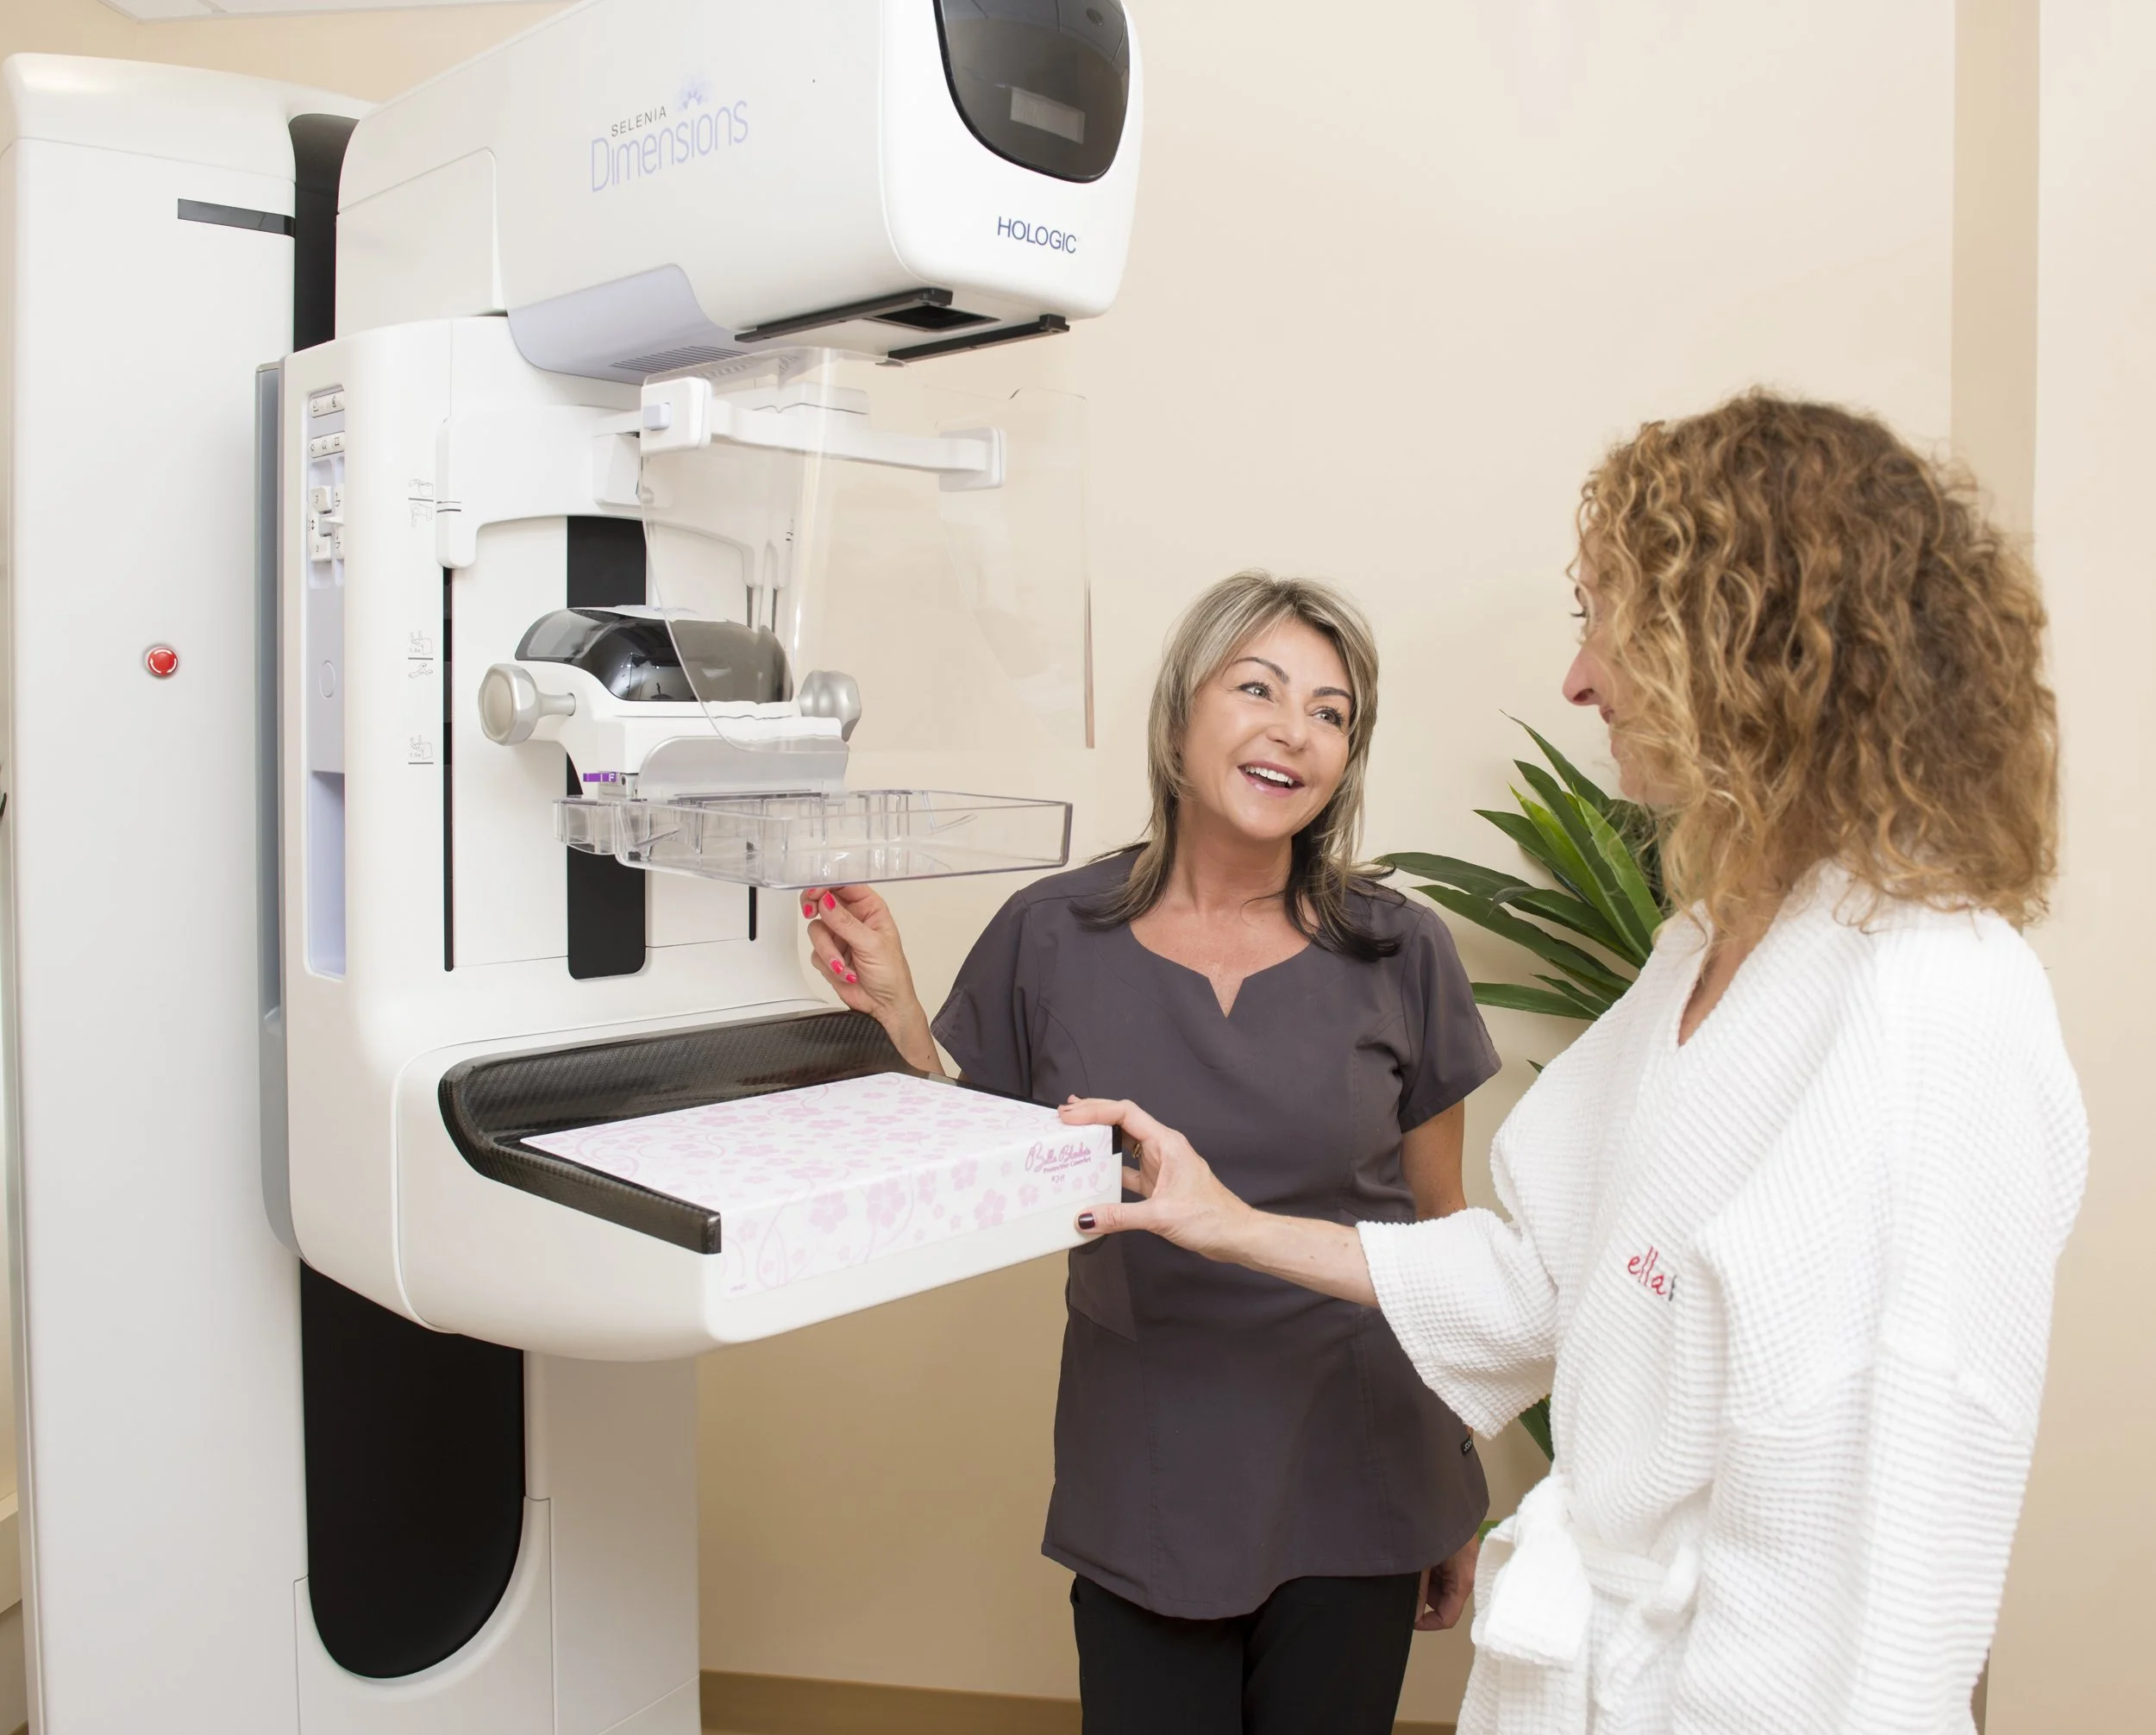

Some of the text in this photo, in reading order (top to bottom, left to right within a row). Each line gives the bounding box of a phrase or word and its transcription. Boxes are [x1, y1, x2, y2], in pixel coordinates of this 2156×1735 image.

[611, 105, 667, 137] SELENIA
[591, 99, 749, 192] Dimensions
[997, 216, 1077, 254] HOLOGIC
[1627, 1244, 1666, 1295] ella
